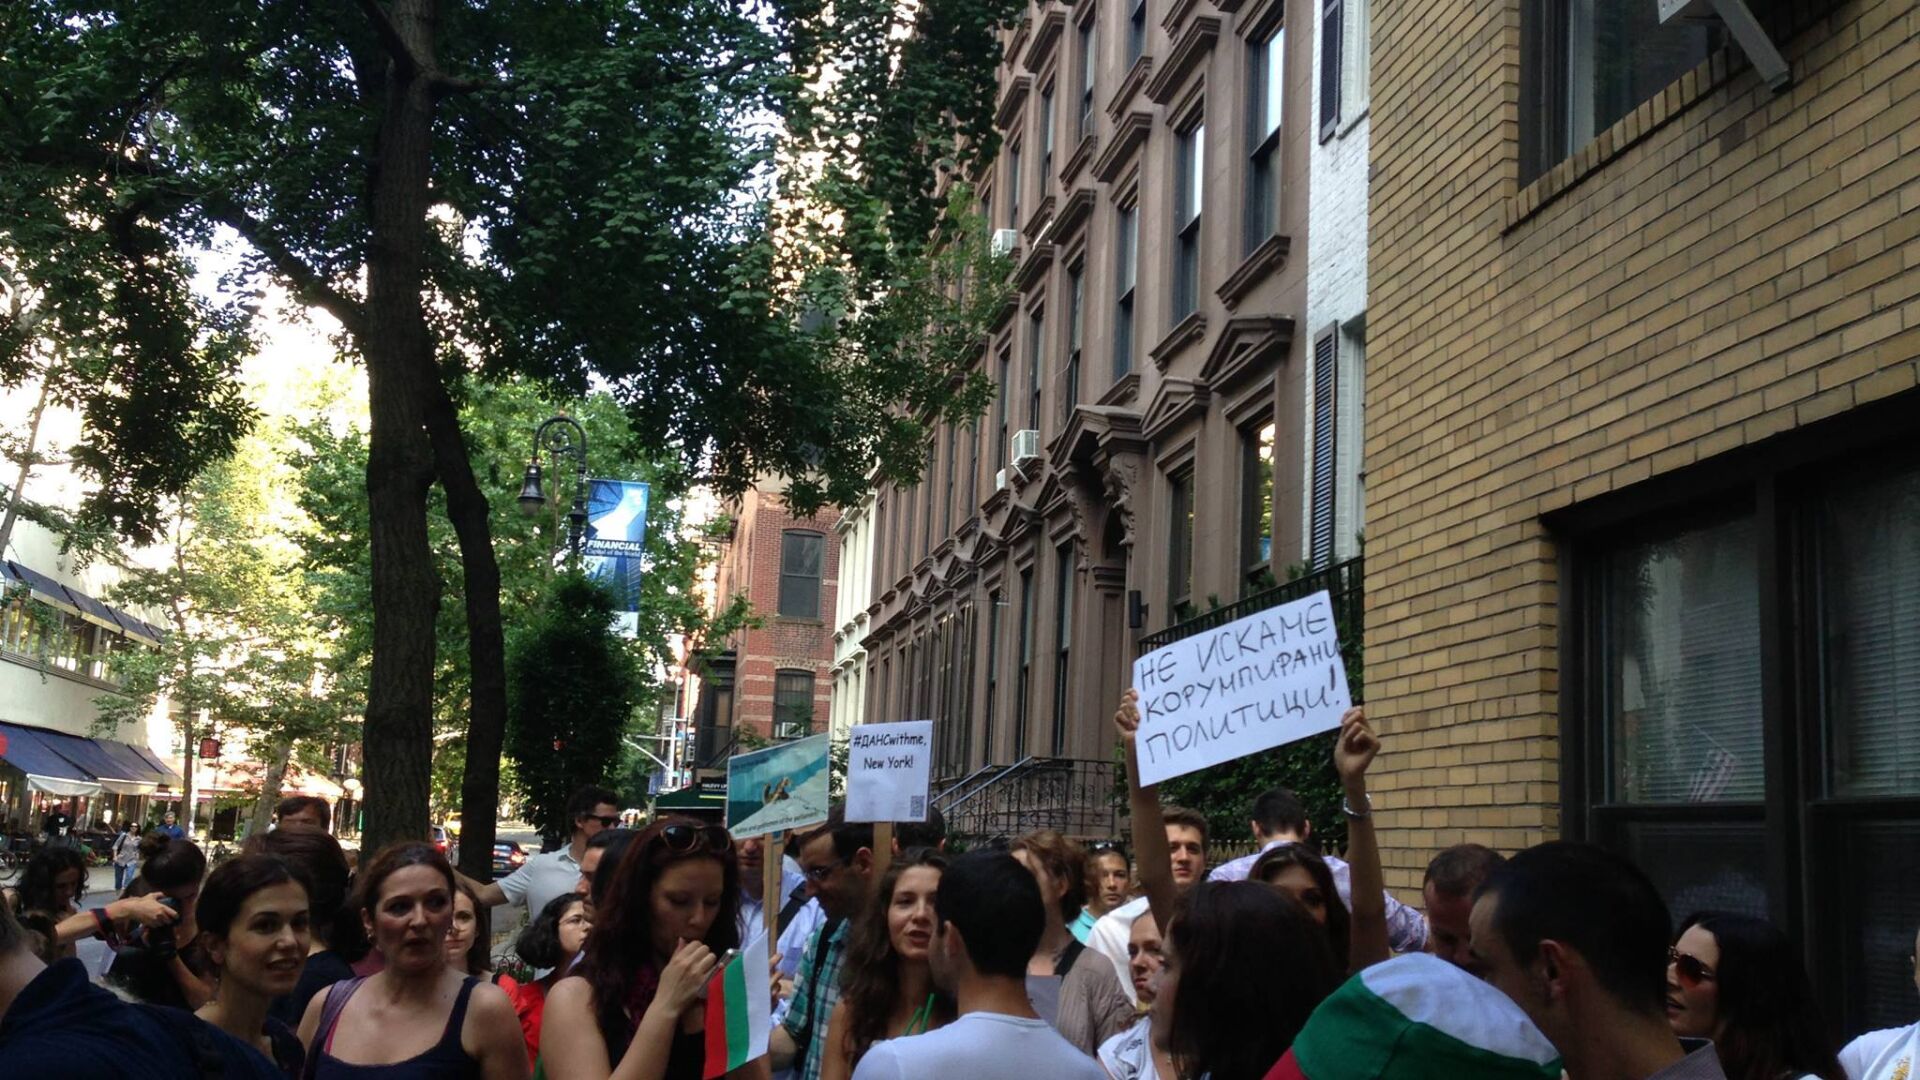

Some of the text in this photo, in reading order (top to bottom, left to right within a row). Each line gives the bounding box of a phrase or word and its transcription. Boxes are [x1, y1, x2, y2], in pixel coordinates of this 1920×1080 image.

[587, 539, 641, 551] FINANCIAL
[1140, 601, 1328, 692] НЕ ИСКАМЕ
[1144, 638, 1341, 723] КОРУМПИРАНИ
[1145, 664, 1341, 764] ПОЛИТИЦИ!
[863, 754, 914, 770] New York!
